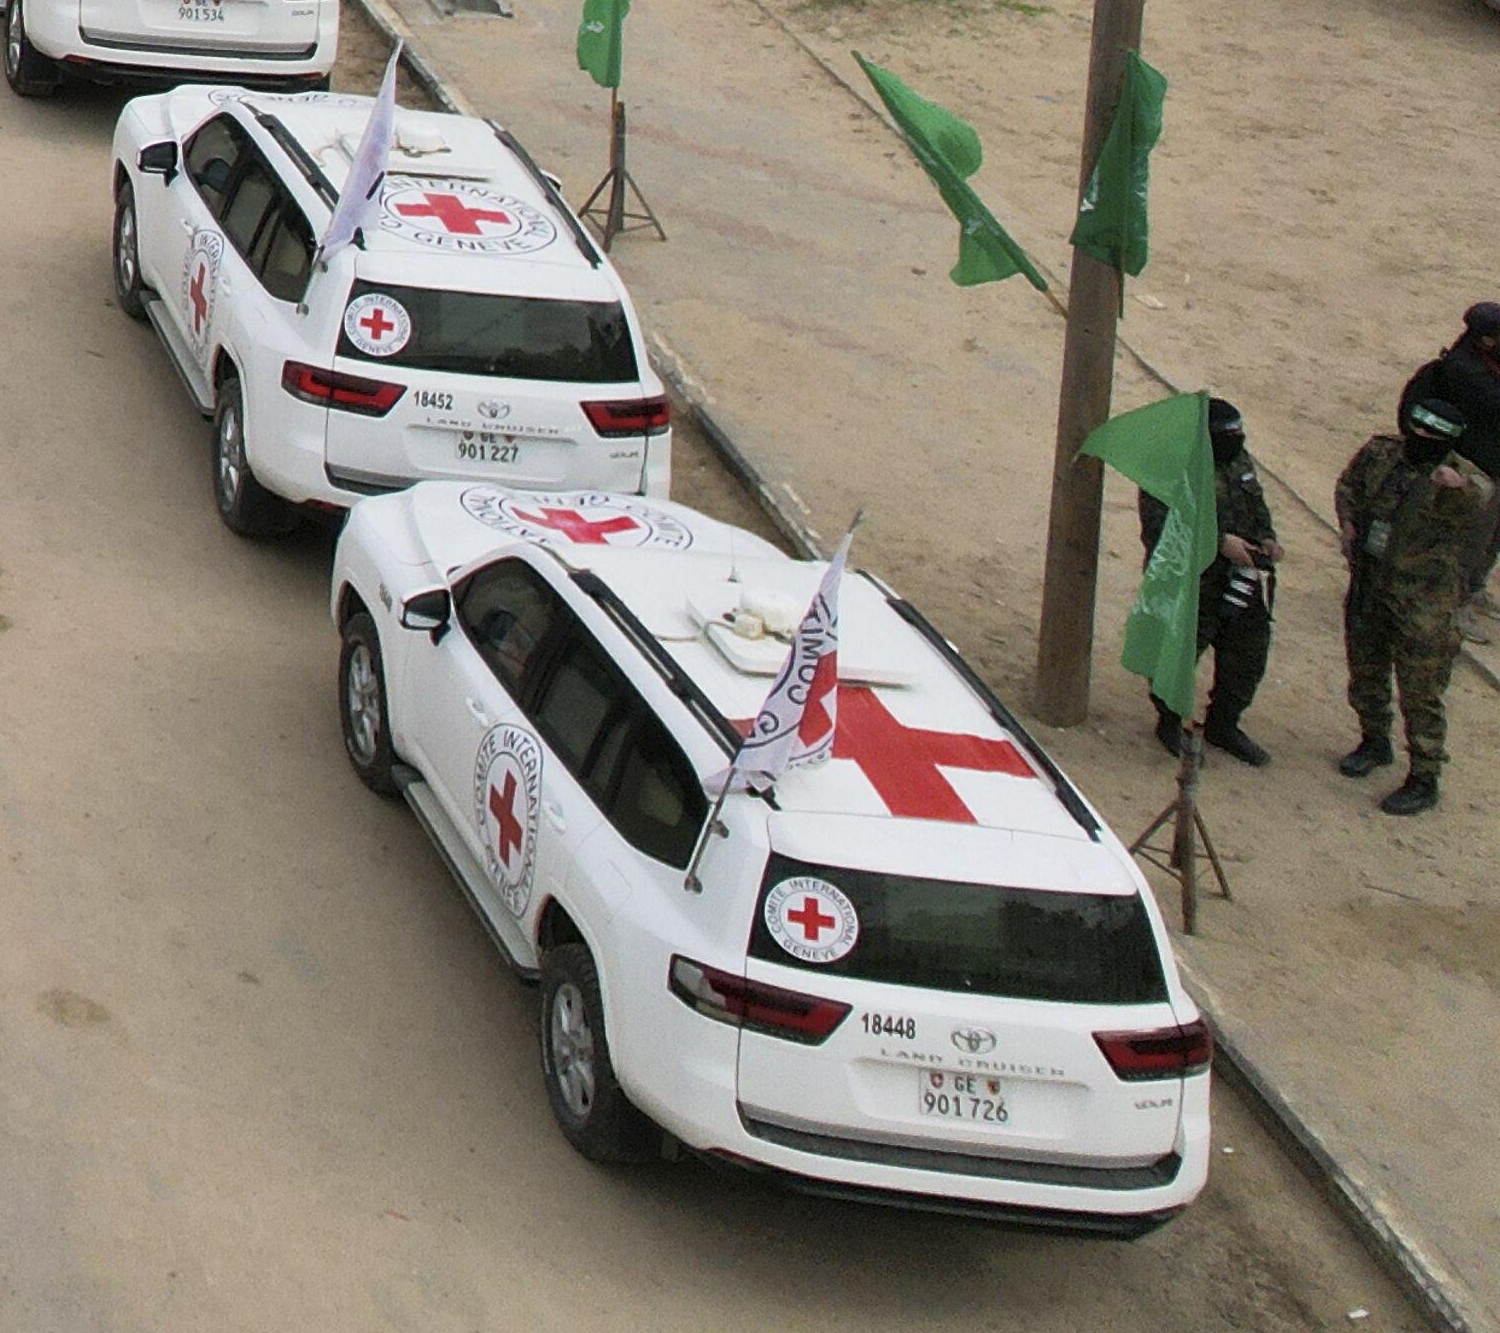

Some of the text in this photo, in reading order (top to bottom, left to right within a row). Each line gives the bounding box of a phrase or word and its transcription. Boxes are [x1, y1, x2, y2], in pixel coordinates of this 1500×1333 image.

[414, 390, 453, 411] 18452
[767, 878, 857, 947] COMITE INTERNATIONAL
[782, 938, 837, 961] GENEVE
[861, 1012, 916, 1040] 18448
[954, 1076, 977, 1095] GE
